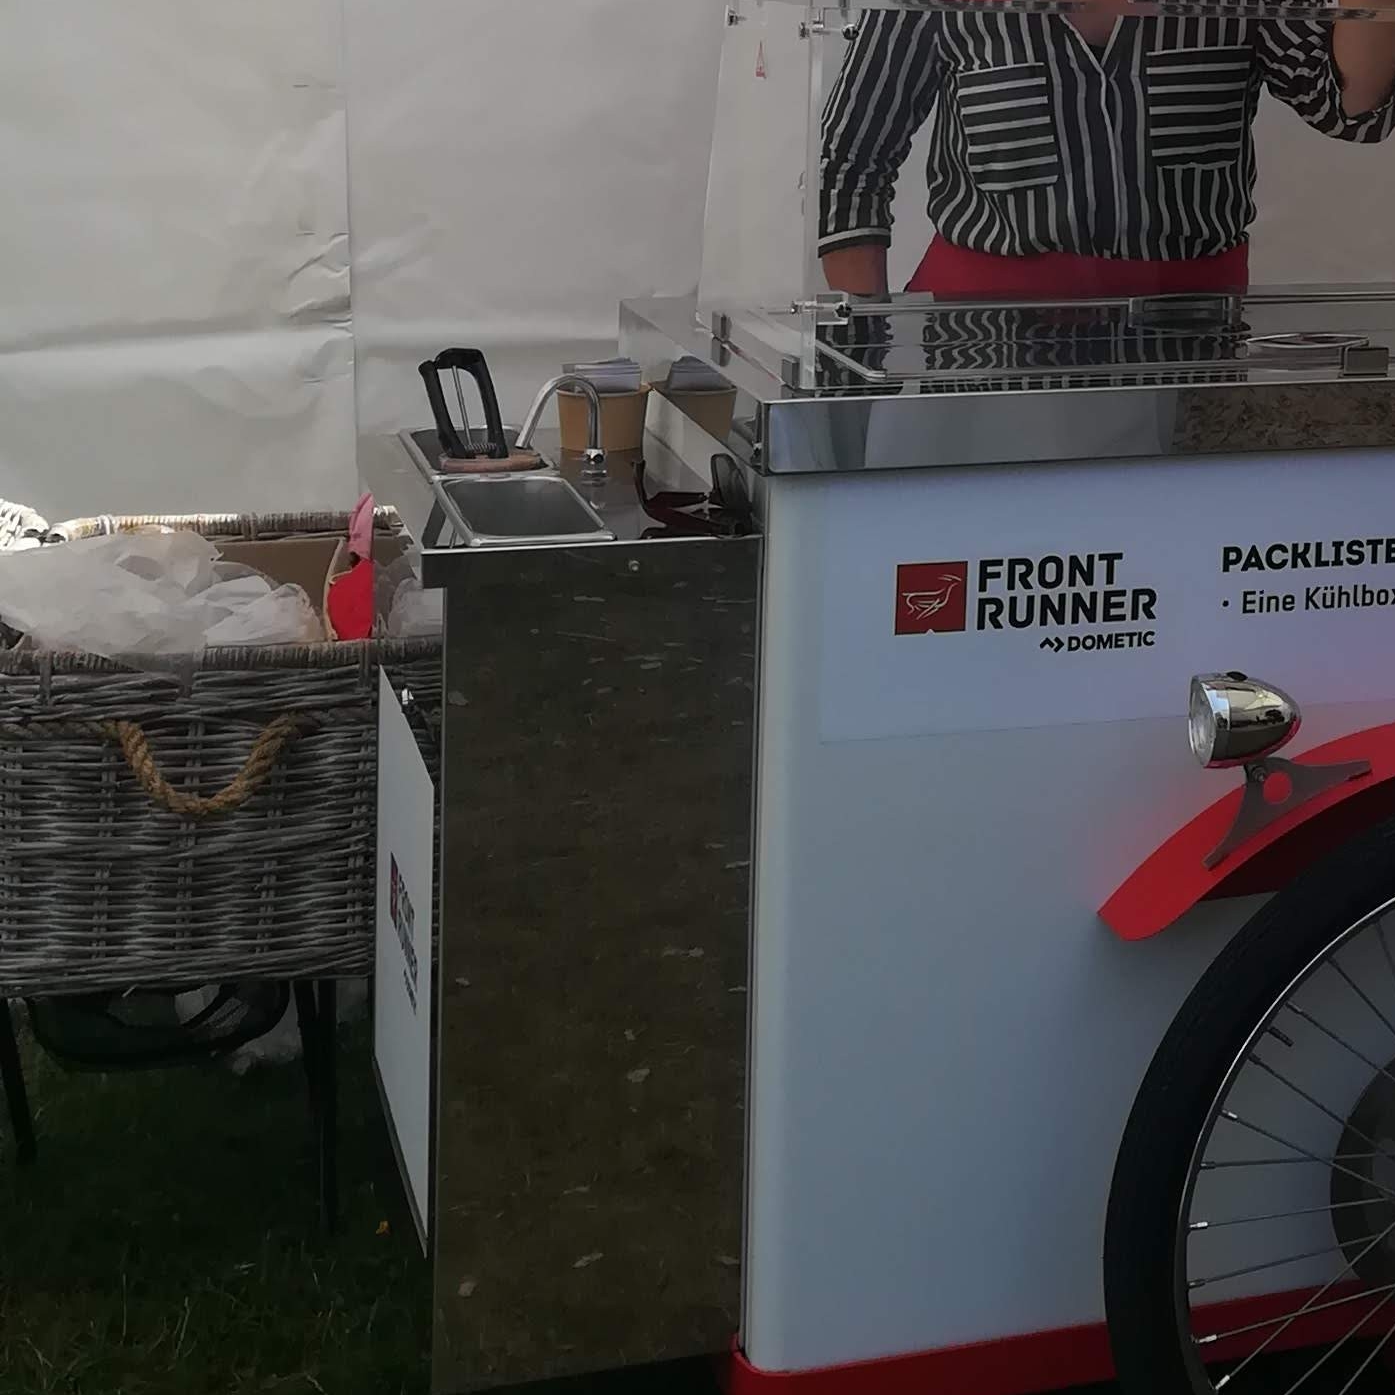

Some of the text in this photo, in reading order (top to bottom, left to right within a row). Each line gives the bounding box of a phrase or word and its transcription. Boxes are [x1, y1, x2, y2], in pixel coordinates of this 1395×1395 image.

[977, 551, 1124, 593] FRONT
[976, 587, 1158, 631] RUNNER
[1241, 589, 1296, 615] Eine
[1066, 630, 1156, 652] DOMETIC
